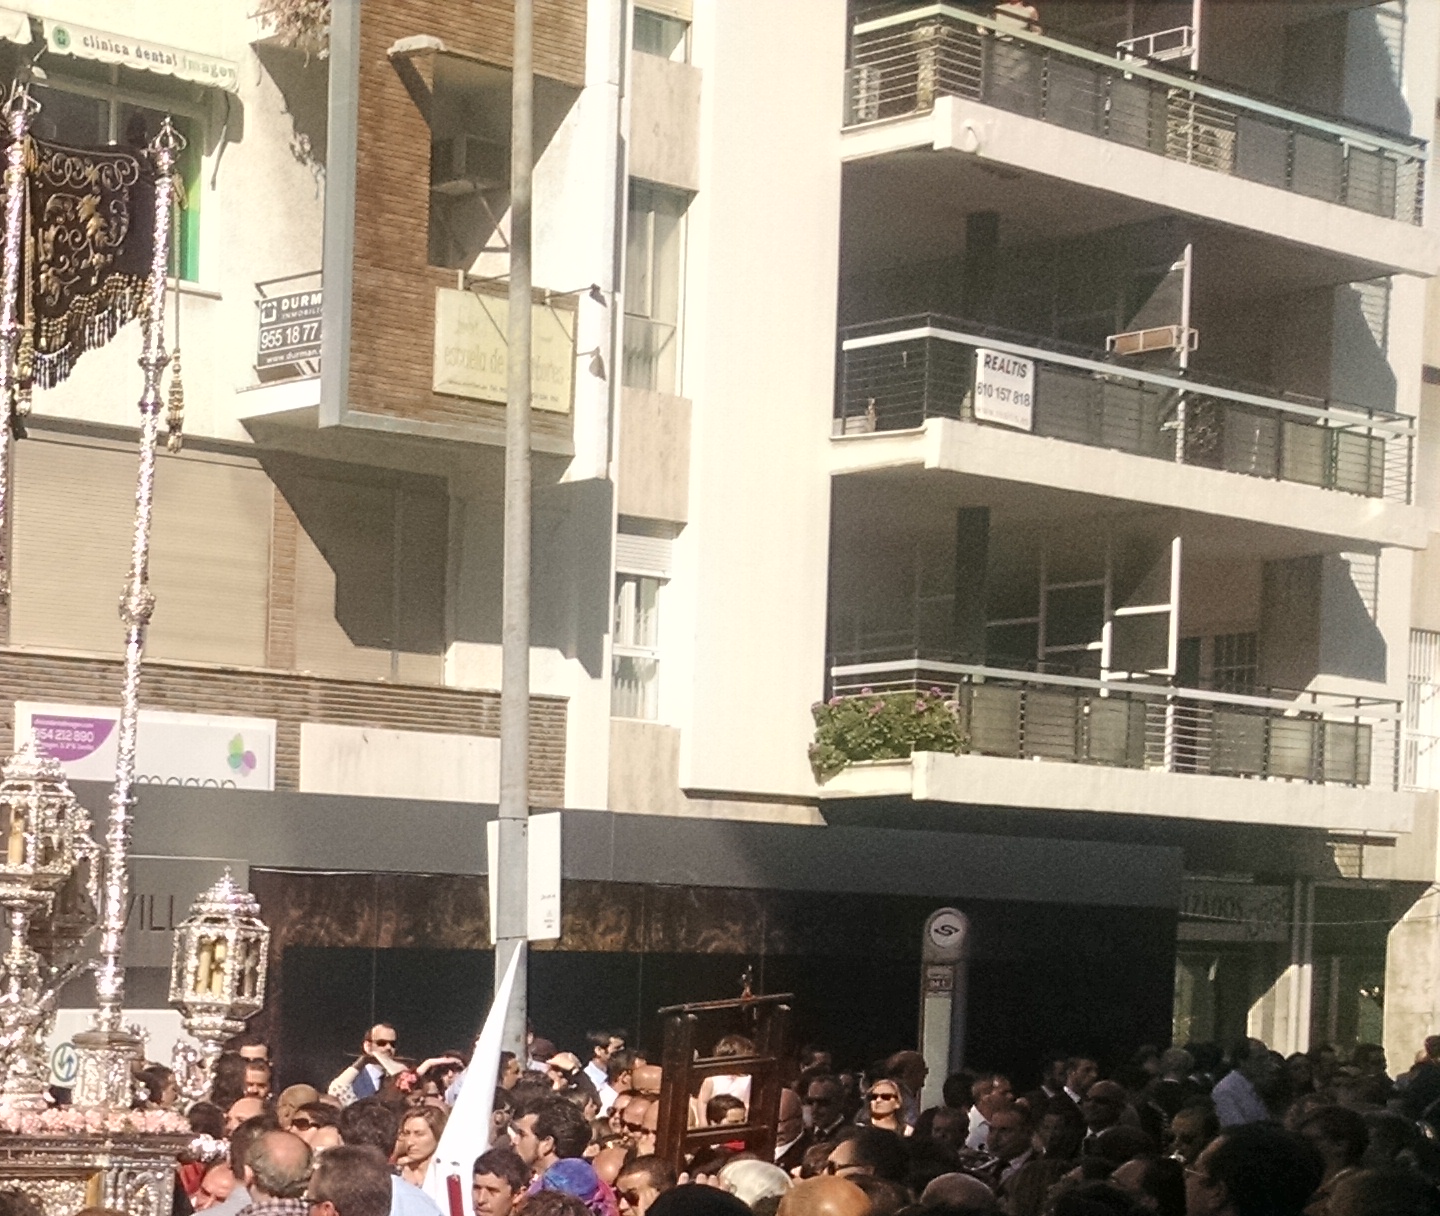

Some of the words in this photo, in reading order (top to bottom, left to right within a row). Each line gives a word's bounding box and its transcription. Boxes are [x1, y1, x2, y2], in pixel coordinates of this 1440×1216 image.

[135, 45, 178, 67] dental
[261, 329, 282, 349] 955
[286, 326, 300, 344] 18
[303, 322, 319, 341] 77
[984, 354, 1028, 378] REALTIS
[977, 382, 993, 398] 610
[995, 387, 1012, 402] 157
[1013, 390, 1031, 407] 818
